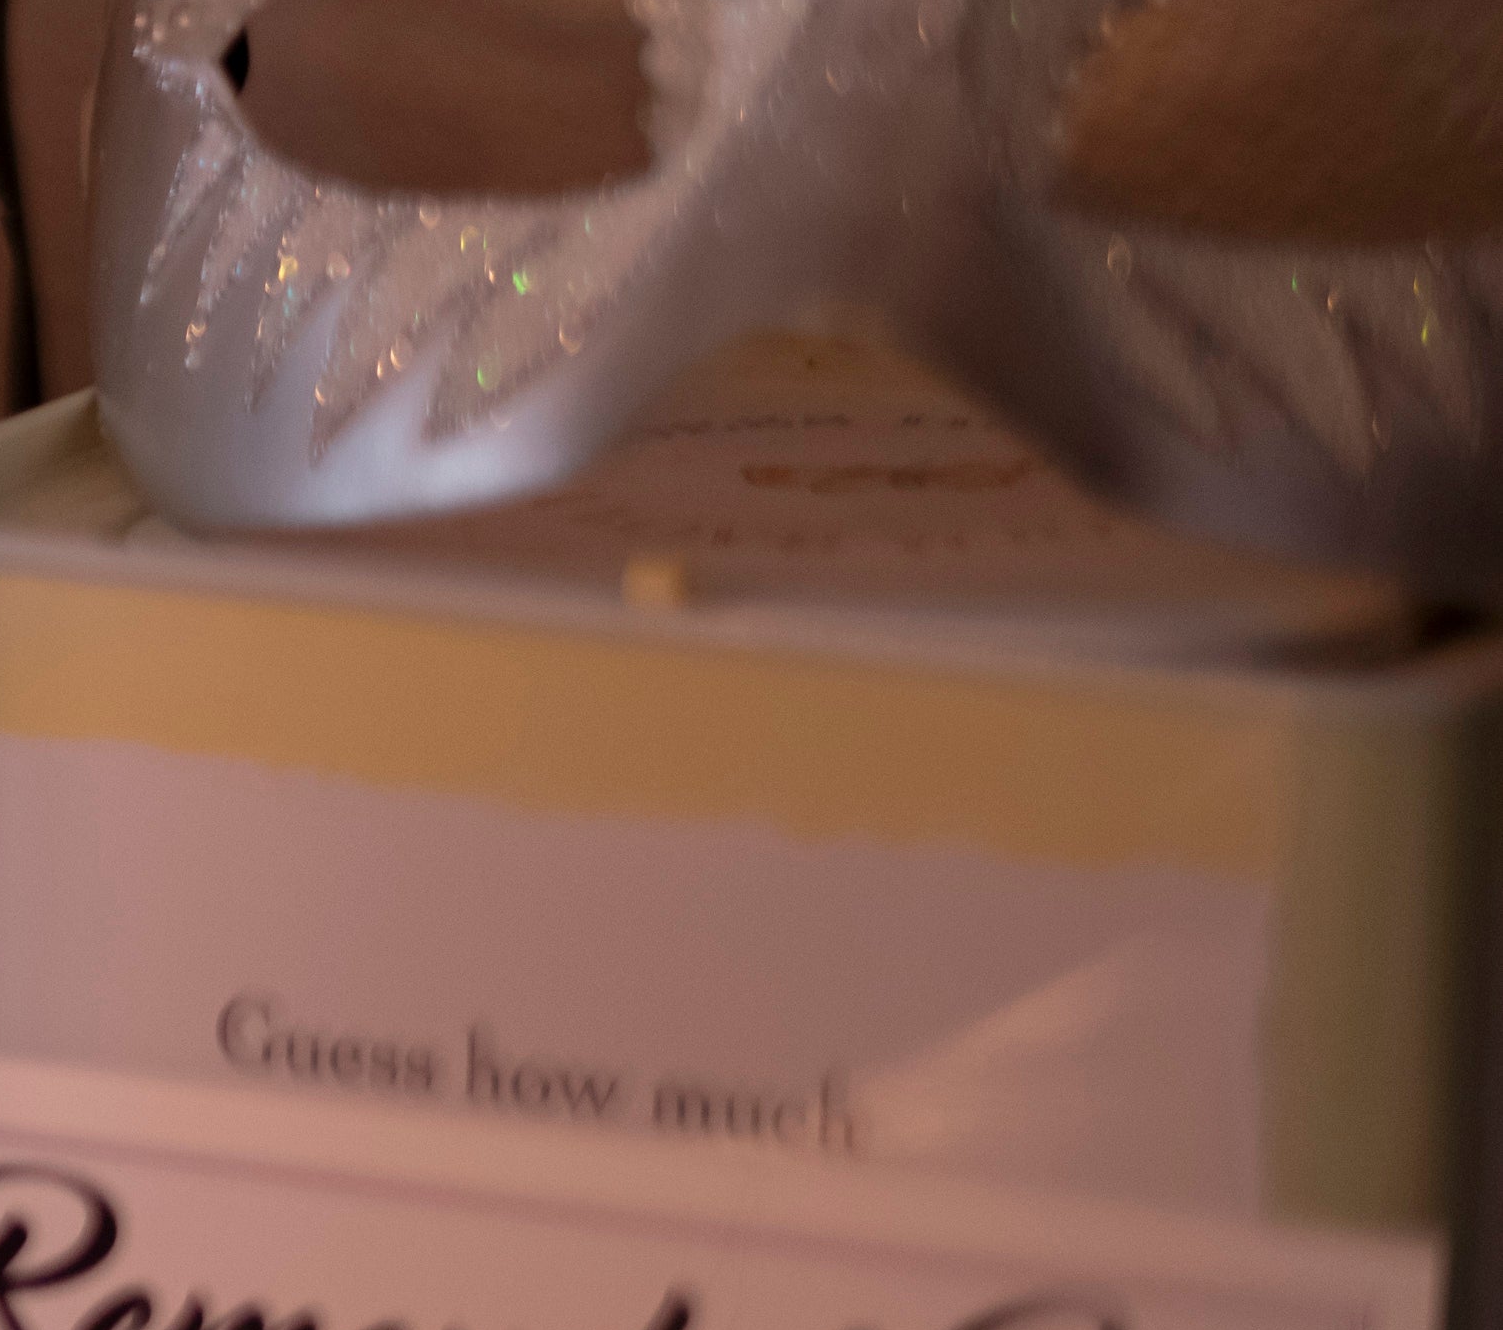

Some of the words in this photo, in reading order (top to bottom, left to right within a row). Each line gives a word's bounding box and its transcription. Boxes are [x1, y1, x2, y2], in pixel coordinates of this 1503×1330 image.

[214, 991, 437, 1089] Guess
[464, 1021, 622, 1109] how
[652, 1071, 857, 1156] much
